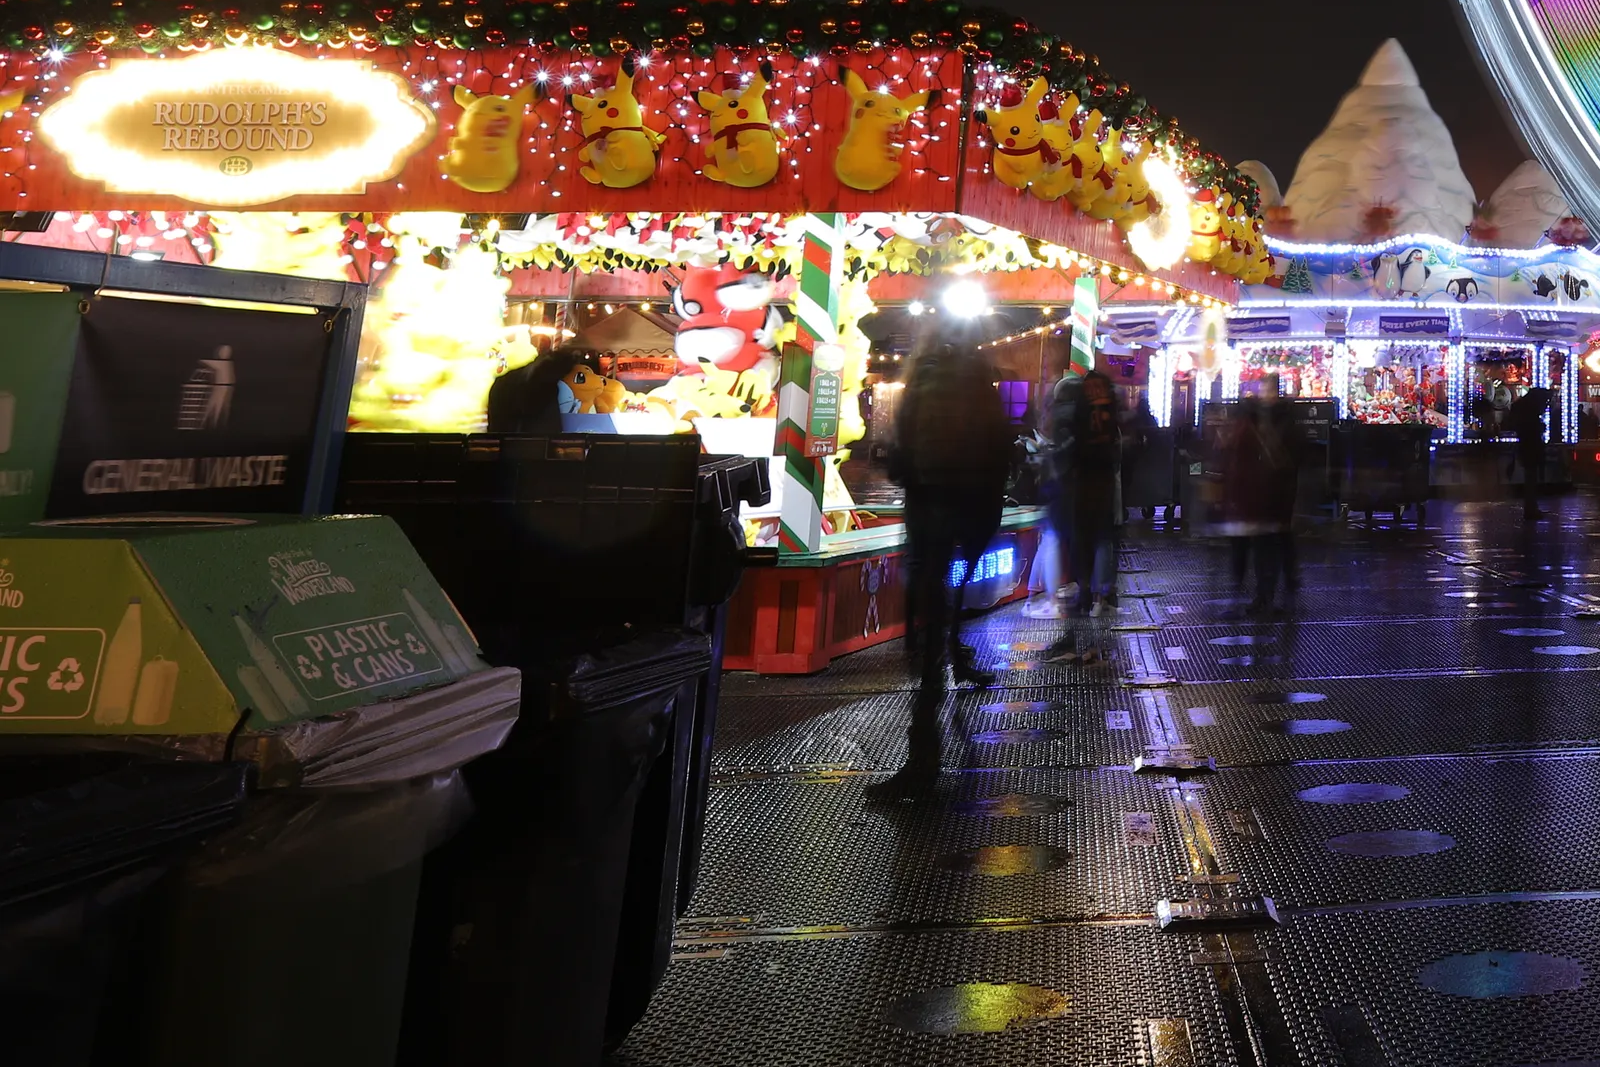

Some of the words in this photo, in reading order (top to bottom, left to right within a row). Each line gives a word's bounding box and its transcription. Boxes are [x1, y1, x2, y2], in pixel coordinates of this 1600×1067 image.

[152, 100, 328, 126] RUDOLPH'S
[162, 127, 315, 151] REBOUND
[1381, 320, 1403, 328] PRIZE
[1405, 319, 1429, 328] EVERY
[1431, 318, 1449, 327] TIME
[82, 459, 195, 495] GENERAL
[203, 455, 289, 488] WASTE
[271, 575, 356, 606] WONDERLAND
[304, 622, 400, 661] PLASTIC
[332, 662, 358, 689] &
[353, 649, 415, 682] CANS
